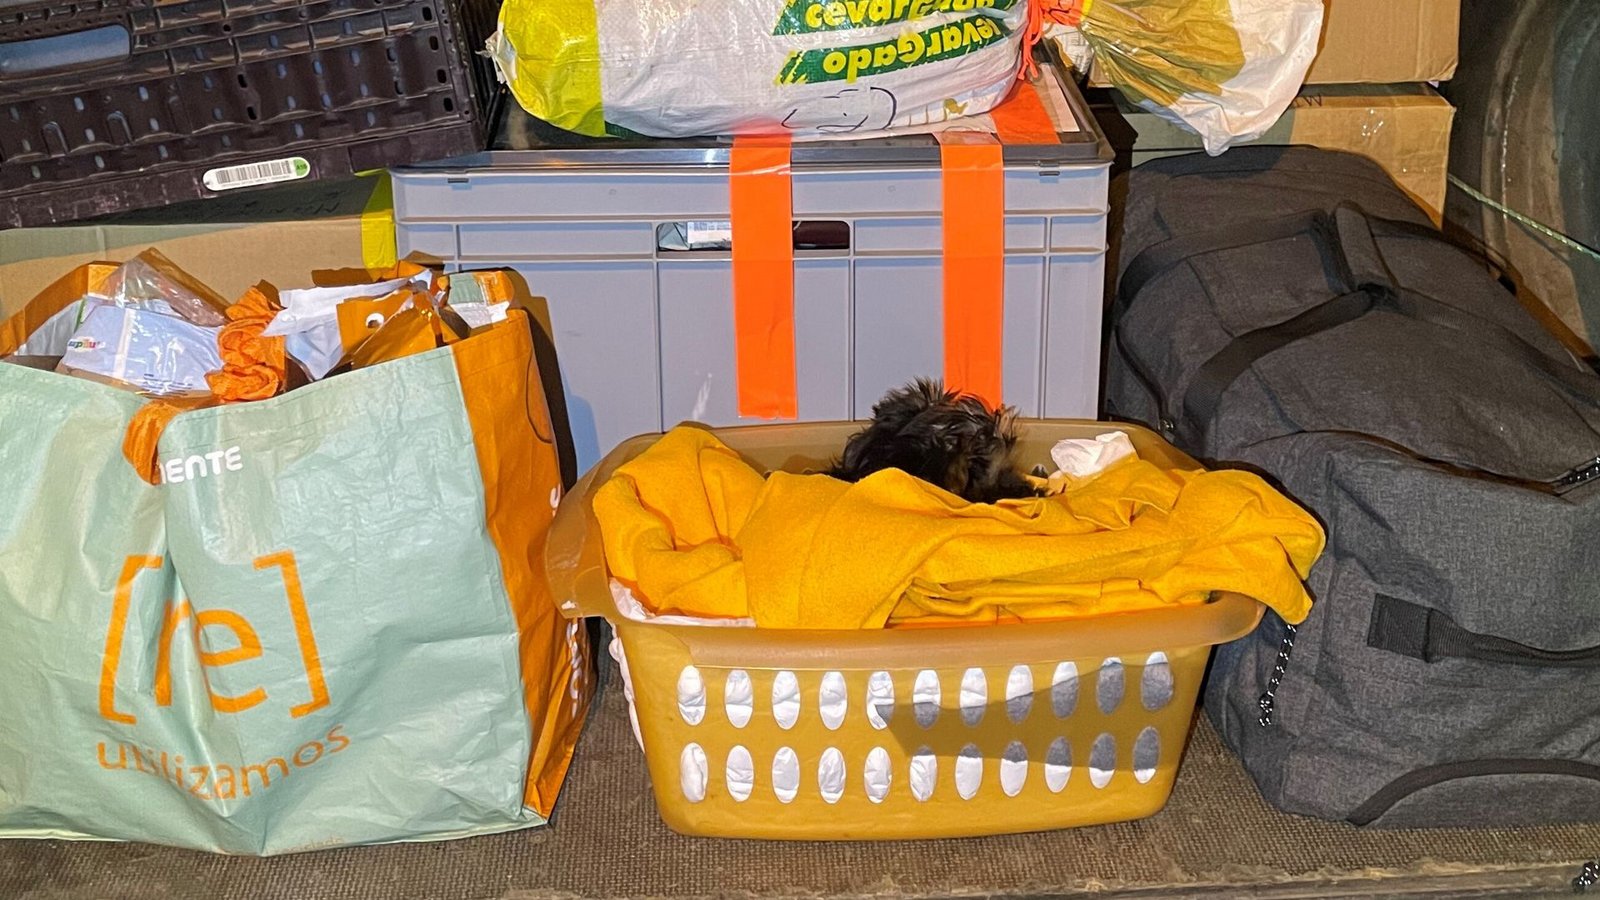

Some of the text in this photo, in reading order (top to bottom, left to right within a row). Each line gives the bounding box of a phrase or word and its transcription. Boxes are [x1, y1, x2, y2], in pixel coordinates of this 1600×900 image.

[806, 0, 995, 28] cevarG
[159, 445, 243, 485] ENTE
[97, 724, 350, 801] utilizamos
